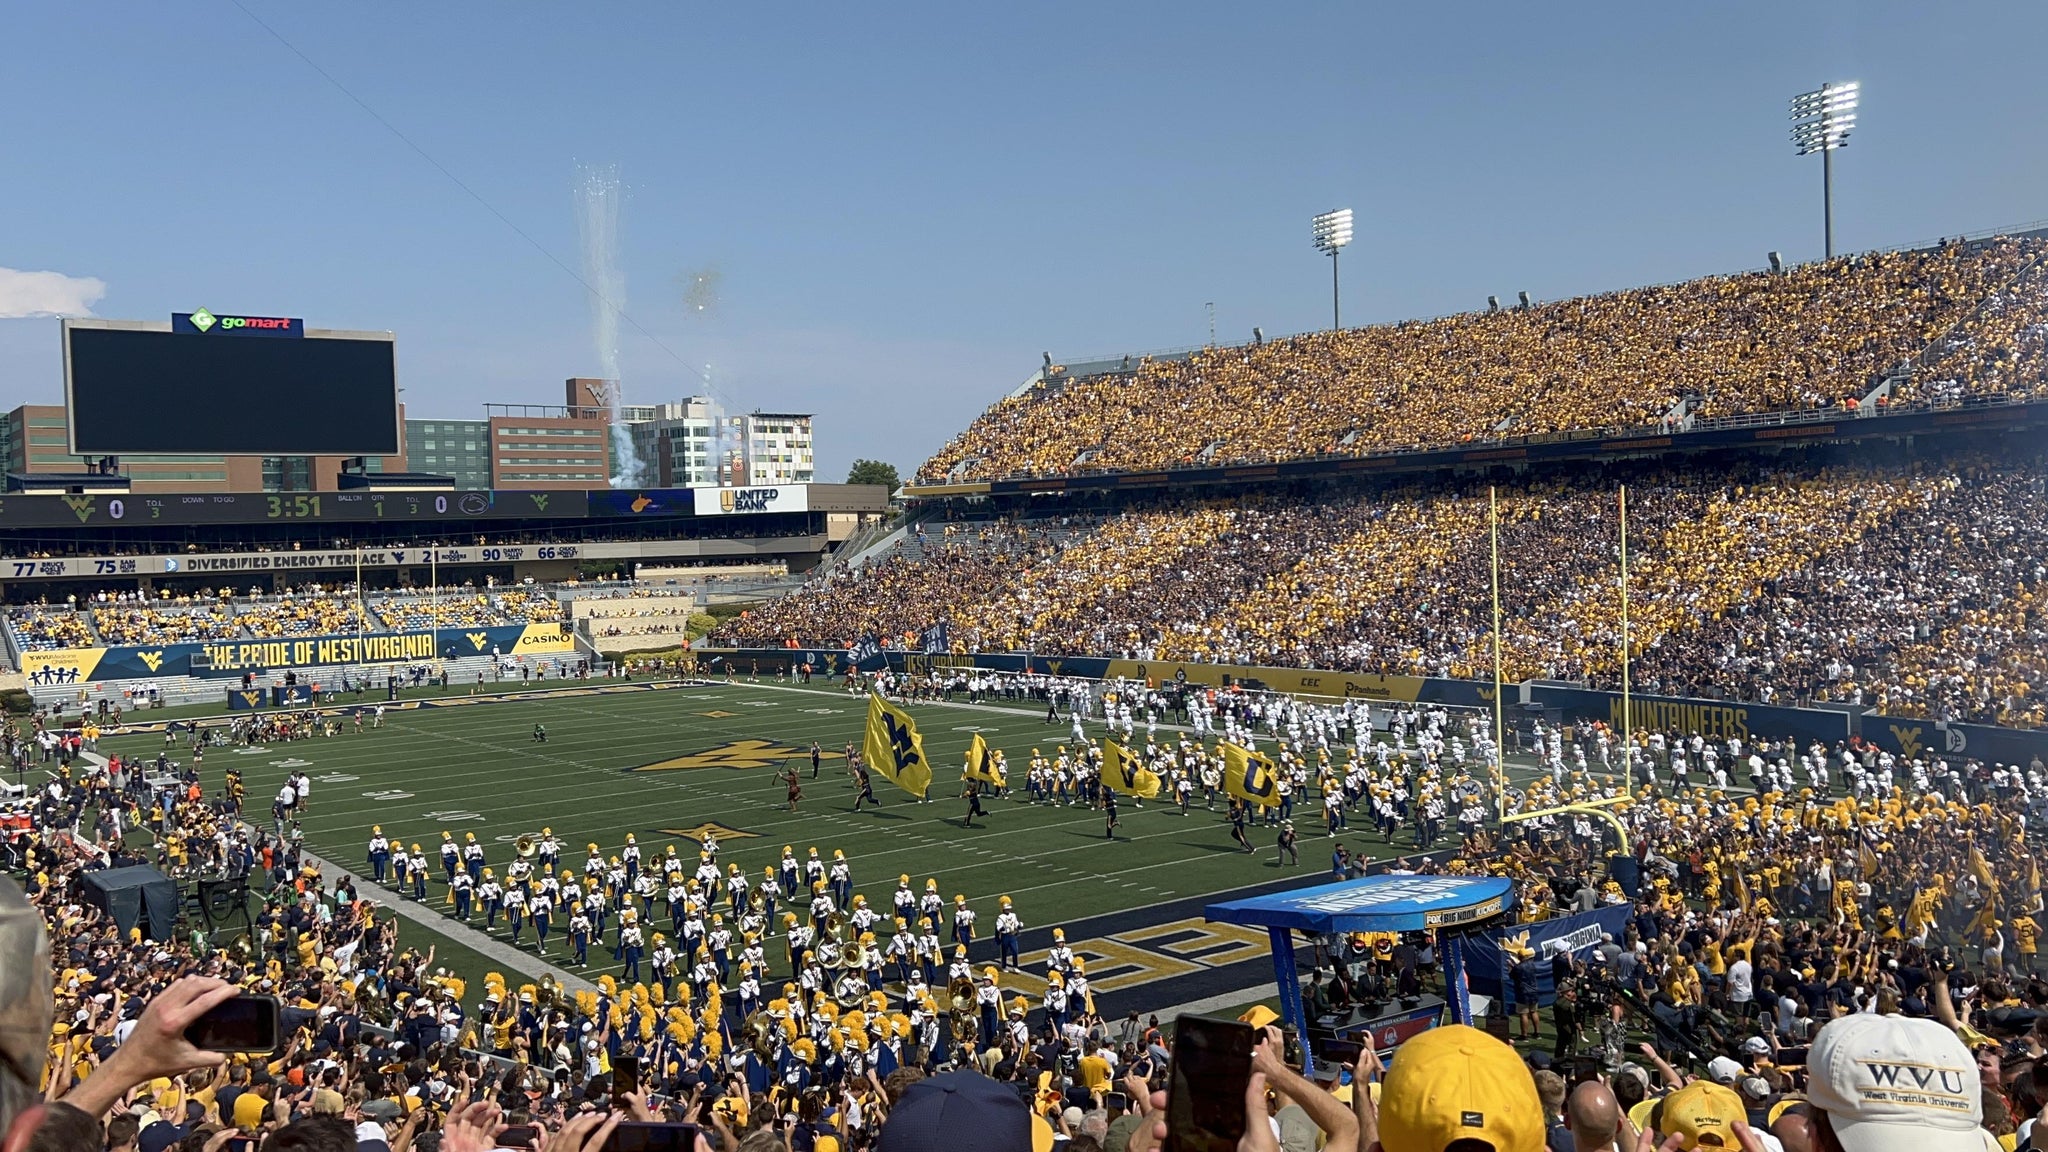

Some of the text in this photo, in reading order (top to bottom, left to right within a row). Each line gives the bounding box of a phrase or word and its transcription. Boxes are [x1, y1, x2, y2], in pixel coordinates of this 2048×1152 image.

[221, 317, 290, 329] gomart
[735, 489, 778, 500] UNITED
[109, 500, 124, 518] 0
[267, 496, 321, 518] 3:51
[374, 502, 383, 516] 1
[410, 504, 418, 514] 3
[435, 496, 447, 513] 0
[735, 500, 768, 511] BANK
[151, 507, 160, 518] 3
[482, 548, 500, 560] 90
[538, 547, 555, 559] 66
[13, 562, 36, 577] 77
[94, 560, 117, 574] 75
[187, 557, 270, 571] DIVERSIFIED
[273, 555, 325, 569] ENERGY
[522, 633, 571, 645] CASINO
[203, 634, 433, 670] THE PRIDE OF WEST VIRGINIA
[1354, 686, 1391, 696] Panhandle
[1426, 901, 1501, 924] FOX BIG NOON KICKOFF
[1866, 1063, 1963, 1095] WVU
[1863, 1091, 1969, 1109] West Virginia University
